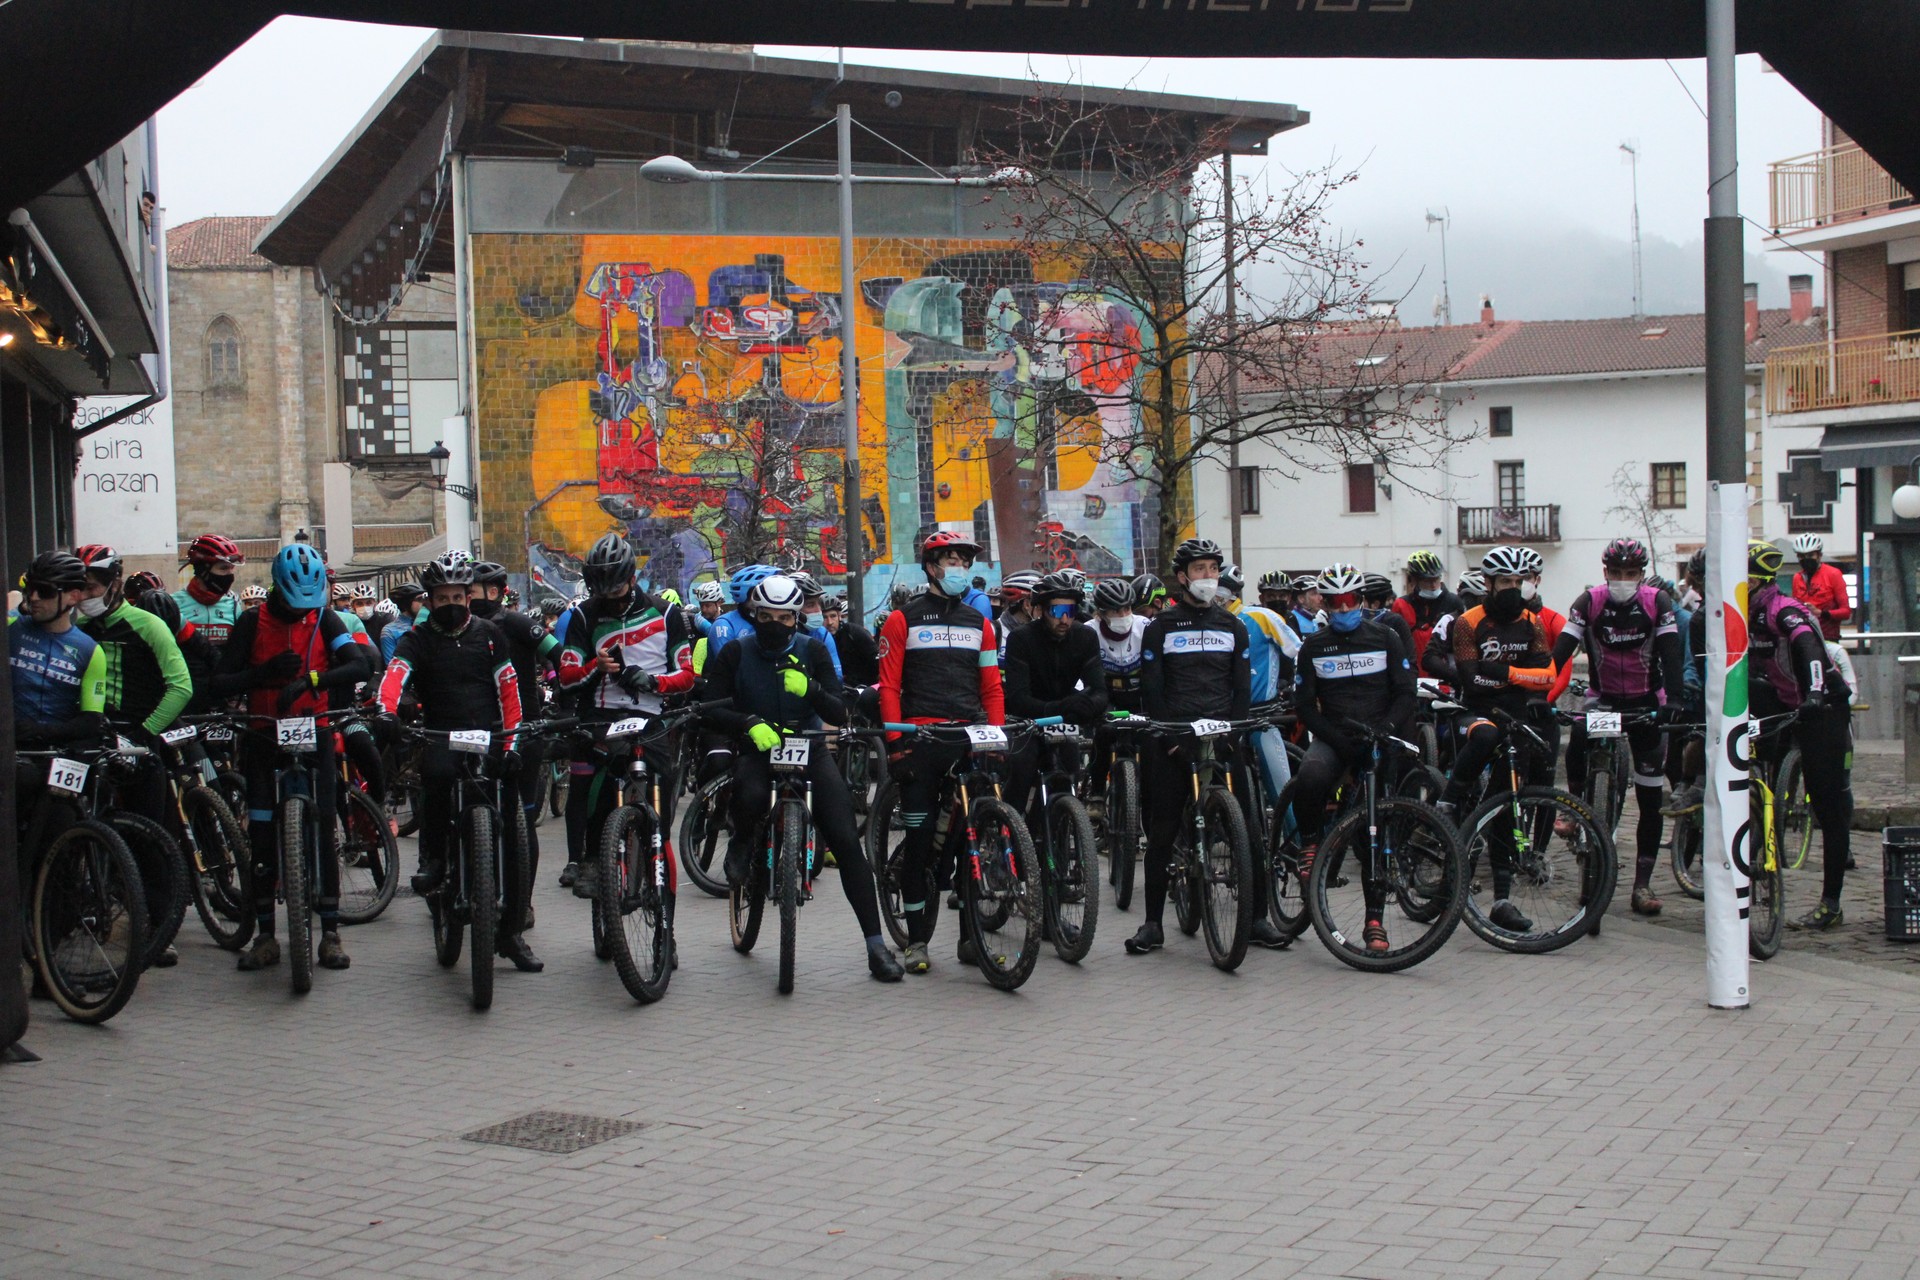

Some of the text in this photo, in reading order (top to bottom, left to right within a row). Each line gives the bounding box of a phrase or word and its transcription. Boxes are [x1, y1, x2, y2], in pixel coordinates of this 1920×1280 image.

[94, 437, 142, 459] bira
[83, 473, 158, 493] nazan
[934, 632, 971, 642] azcue
[1188, 637, 1225, 646] azcue
[1337, 658, 1374, 671] azcue
[209, 728, 231, 738] 296
[615, 722, 637, 732] 86
[1198, 720, 1229, 733] 164
[280, 728, 314, 743] 354
[454, 732, 487, 742] 334
[976, 730, 999, 741] 35
[773, 748, 806, 762] 317
[54, 770, 82, 789] 181
